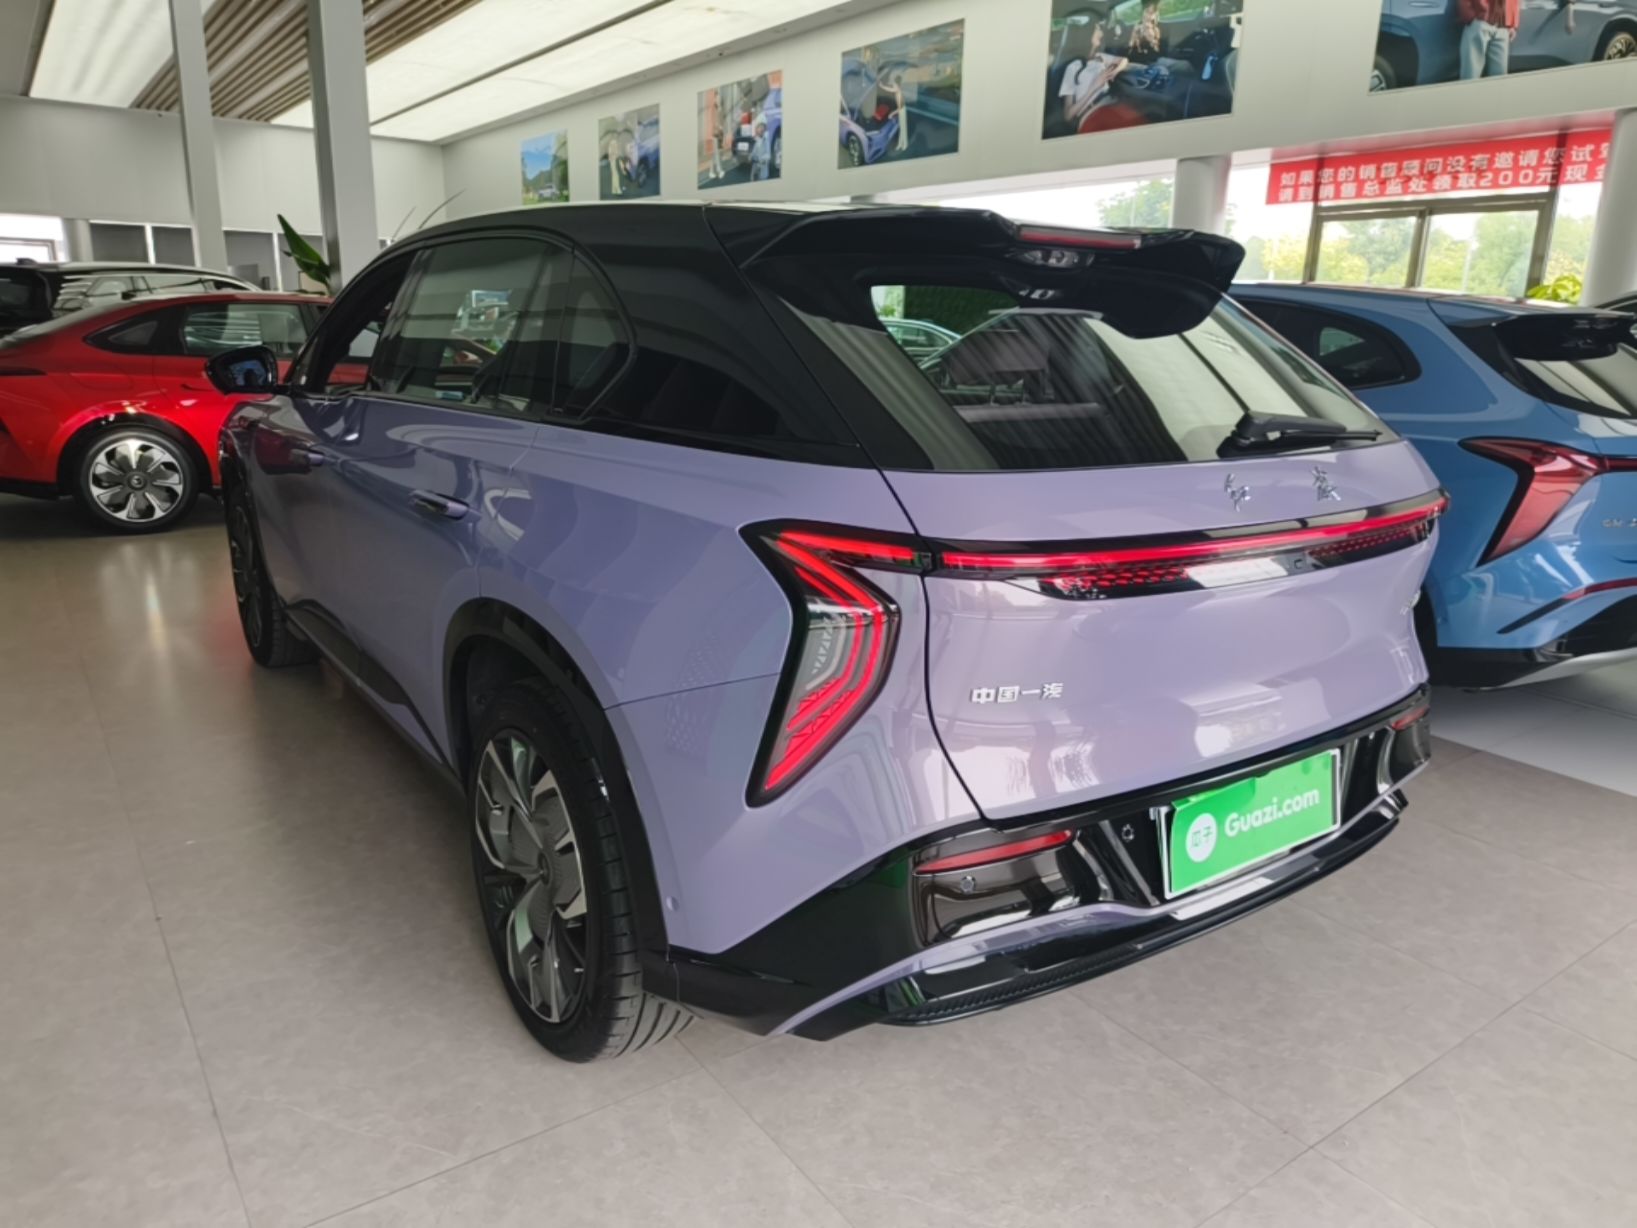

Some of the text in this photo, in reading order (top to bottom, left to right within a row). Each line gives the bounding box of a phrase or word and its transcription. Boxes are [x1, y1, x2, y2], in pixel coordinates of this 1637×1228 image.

[970, 682, 1064, 704] 中国一汽
[1224, 788, 1320, 838] Guazi.com
